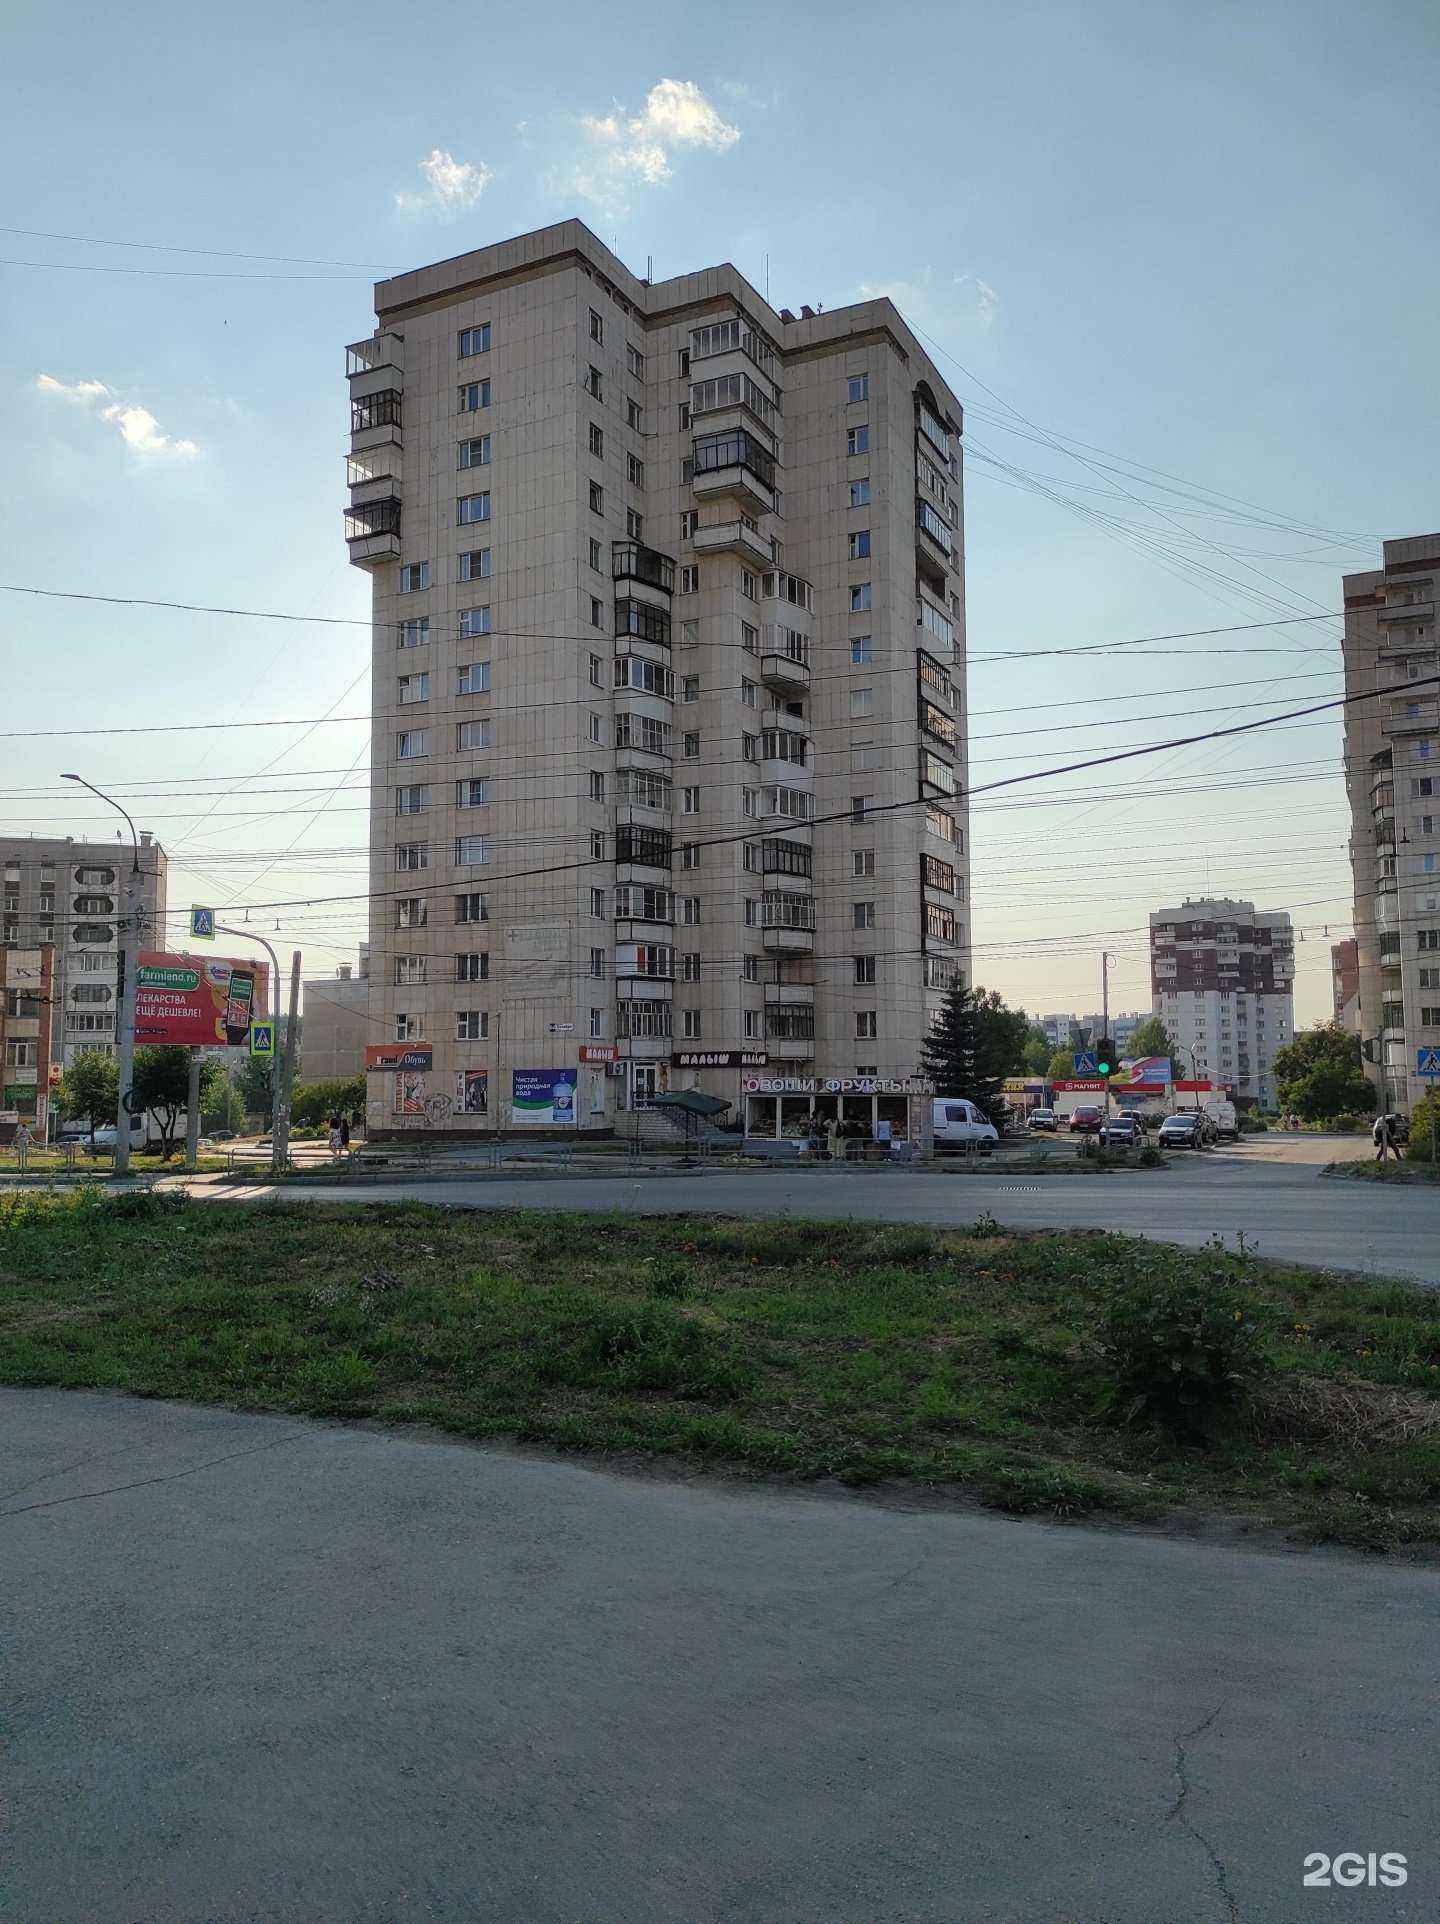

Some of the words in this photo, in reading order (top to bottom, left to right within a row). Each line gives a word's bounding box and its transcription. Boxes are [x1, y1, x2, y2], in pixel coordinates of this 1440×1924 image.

[140, 968, 196, 983] farmland.ru
[136, 993, 186, 1005] ЛЕКАРСТВА
[157, 1006, 201, 1018] ДЕШЕВЛЕ!
[404, 1054, 426, 1066] Обувь
[680, 1054, 730, 1065] МАЛЫШ
[747, 1079, 815, 1092] ОВОЩИ
[825, 1079, 908, 1093] ФРУКТЫ
